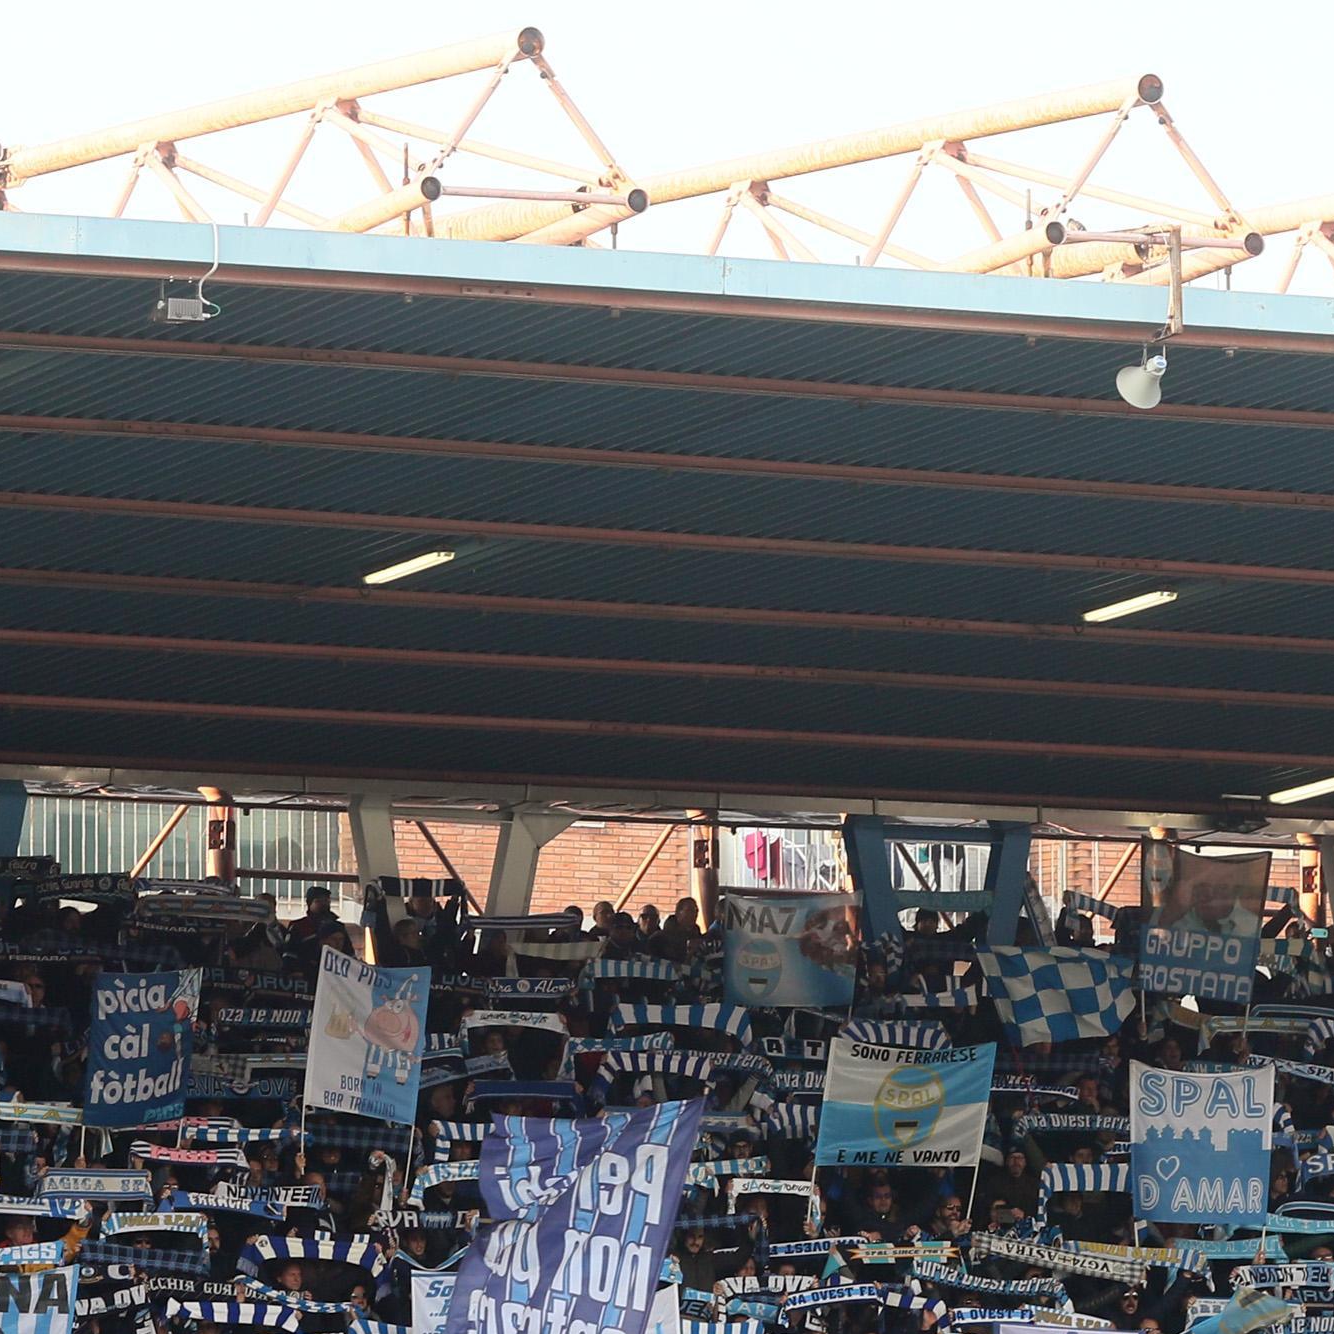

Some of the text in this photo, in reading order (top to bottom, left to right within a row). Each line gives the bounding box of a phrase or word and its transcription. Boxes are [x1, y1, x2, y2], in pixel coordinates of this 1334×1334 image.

[727, 904, 795, 935] MA7
[324, 950, 351, 973] OLD
[1146, 929, 1241, 965] GRUPPO
[97, 981, 166, 1019] pìcia
[104, 1023, 149, 1060] càl
[850, 1043, 979, 1065] SONO FERRARESE
[89, 1064, 181, 1104] fòtball
[324, 1090, 344, 1107] BAR
[340, 1075, 366, 1091] BORN
[1139, 1073, 1266, 1119] SPAL
[837, 1148, 961, 1164] E ME NE VANTO
[1171, 1177, 1262, 1213] AMAR
